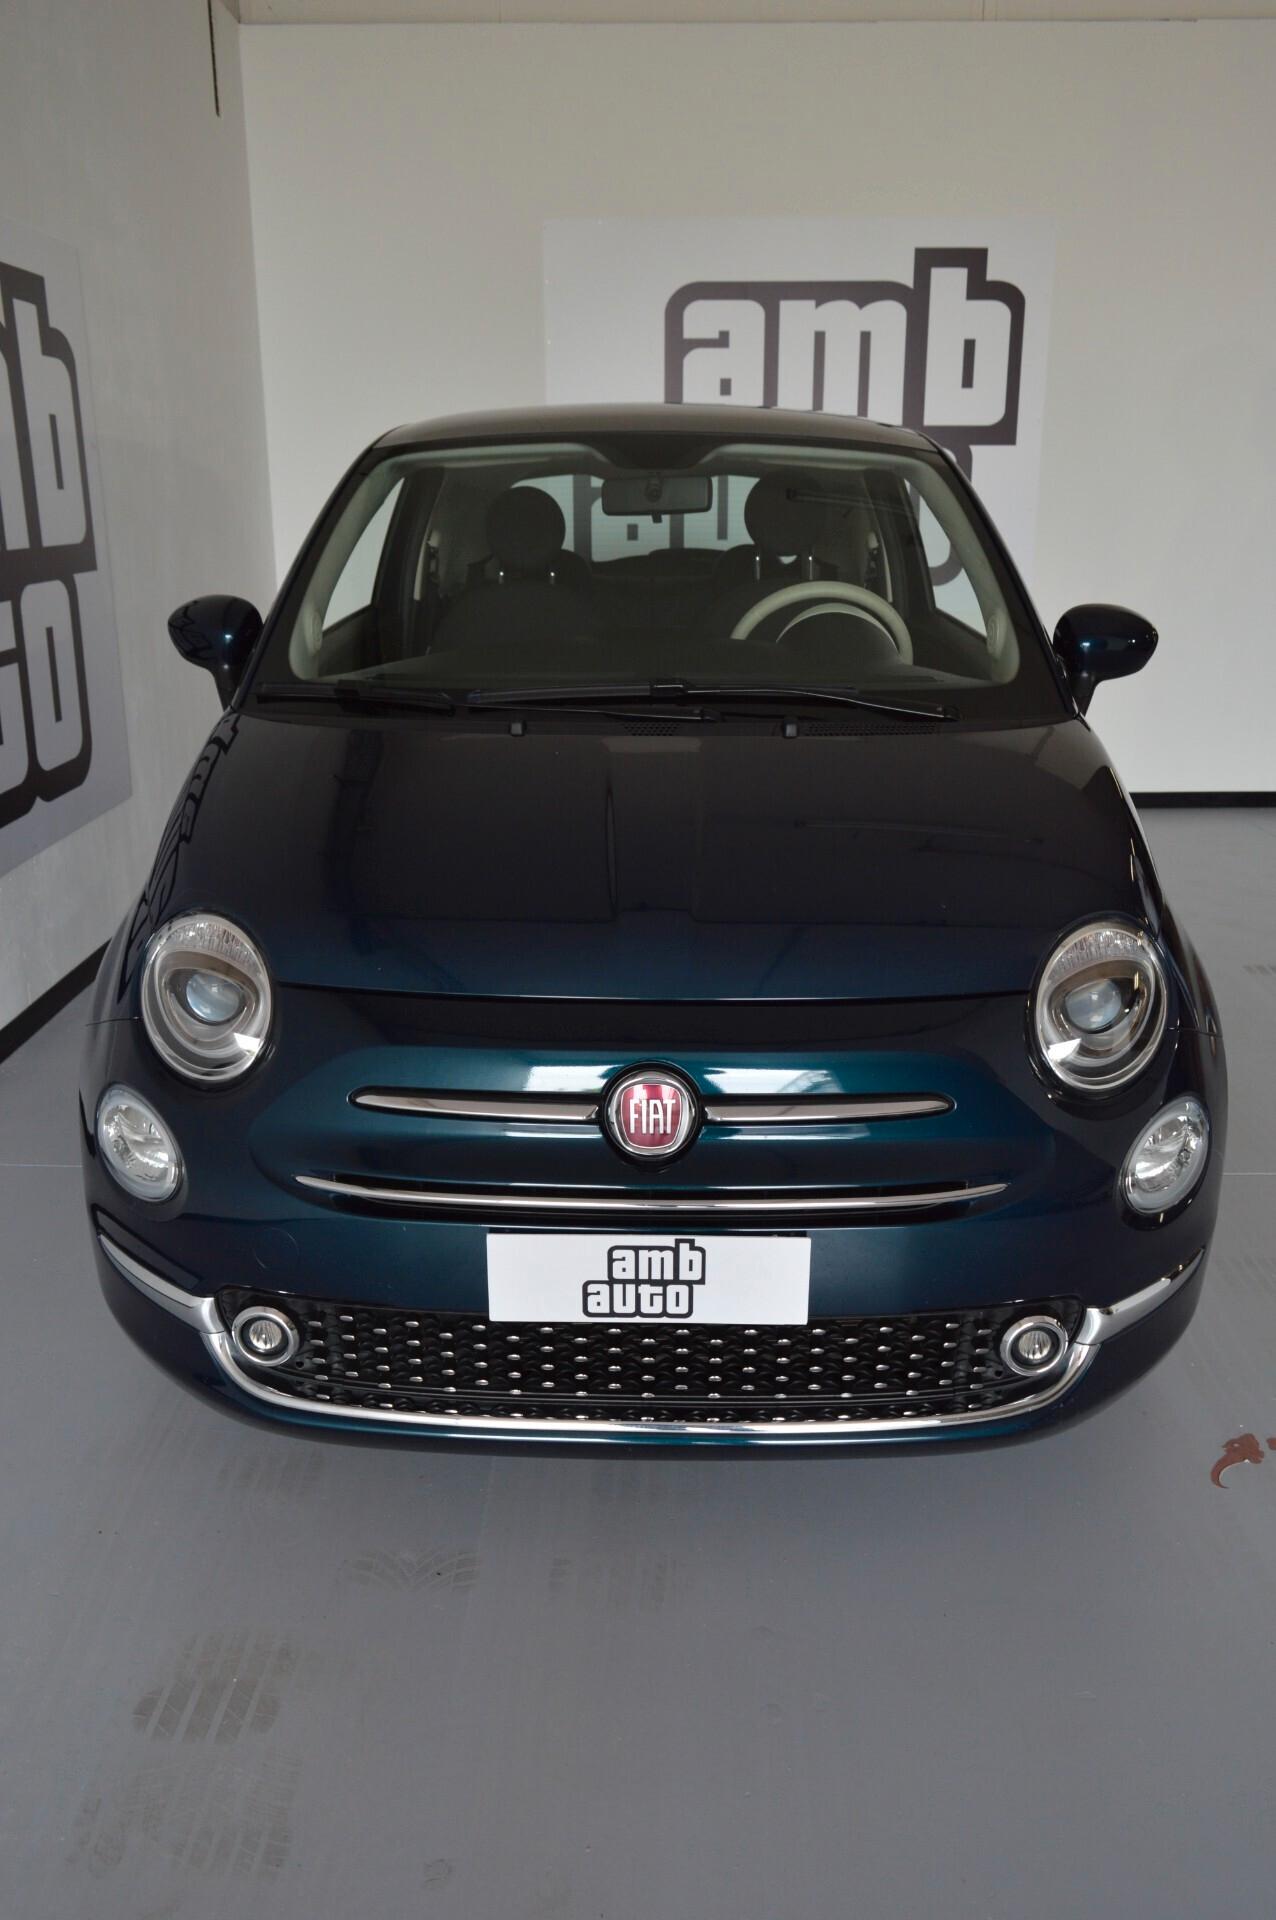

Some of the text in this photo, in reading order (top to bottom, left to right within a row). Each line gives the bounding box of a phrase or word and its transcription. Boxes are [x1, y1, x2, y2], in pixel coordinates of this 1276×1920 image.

[668, 250, 1022, 430] amb
[630, 1099, 676, 1134] FIAT
[608, 1239, 705, 1283] amb
[583, 1281, 693, 1318] auto
